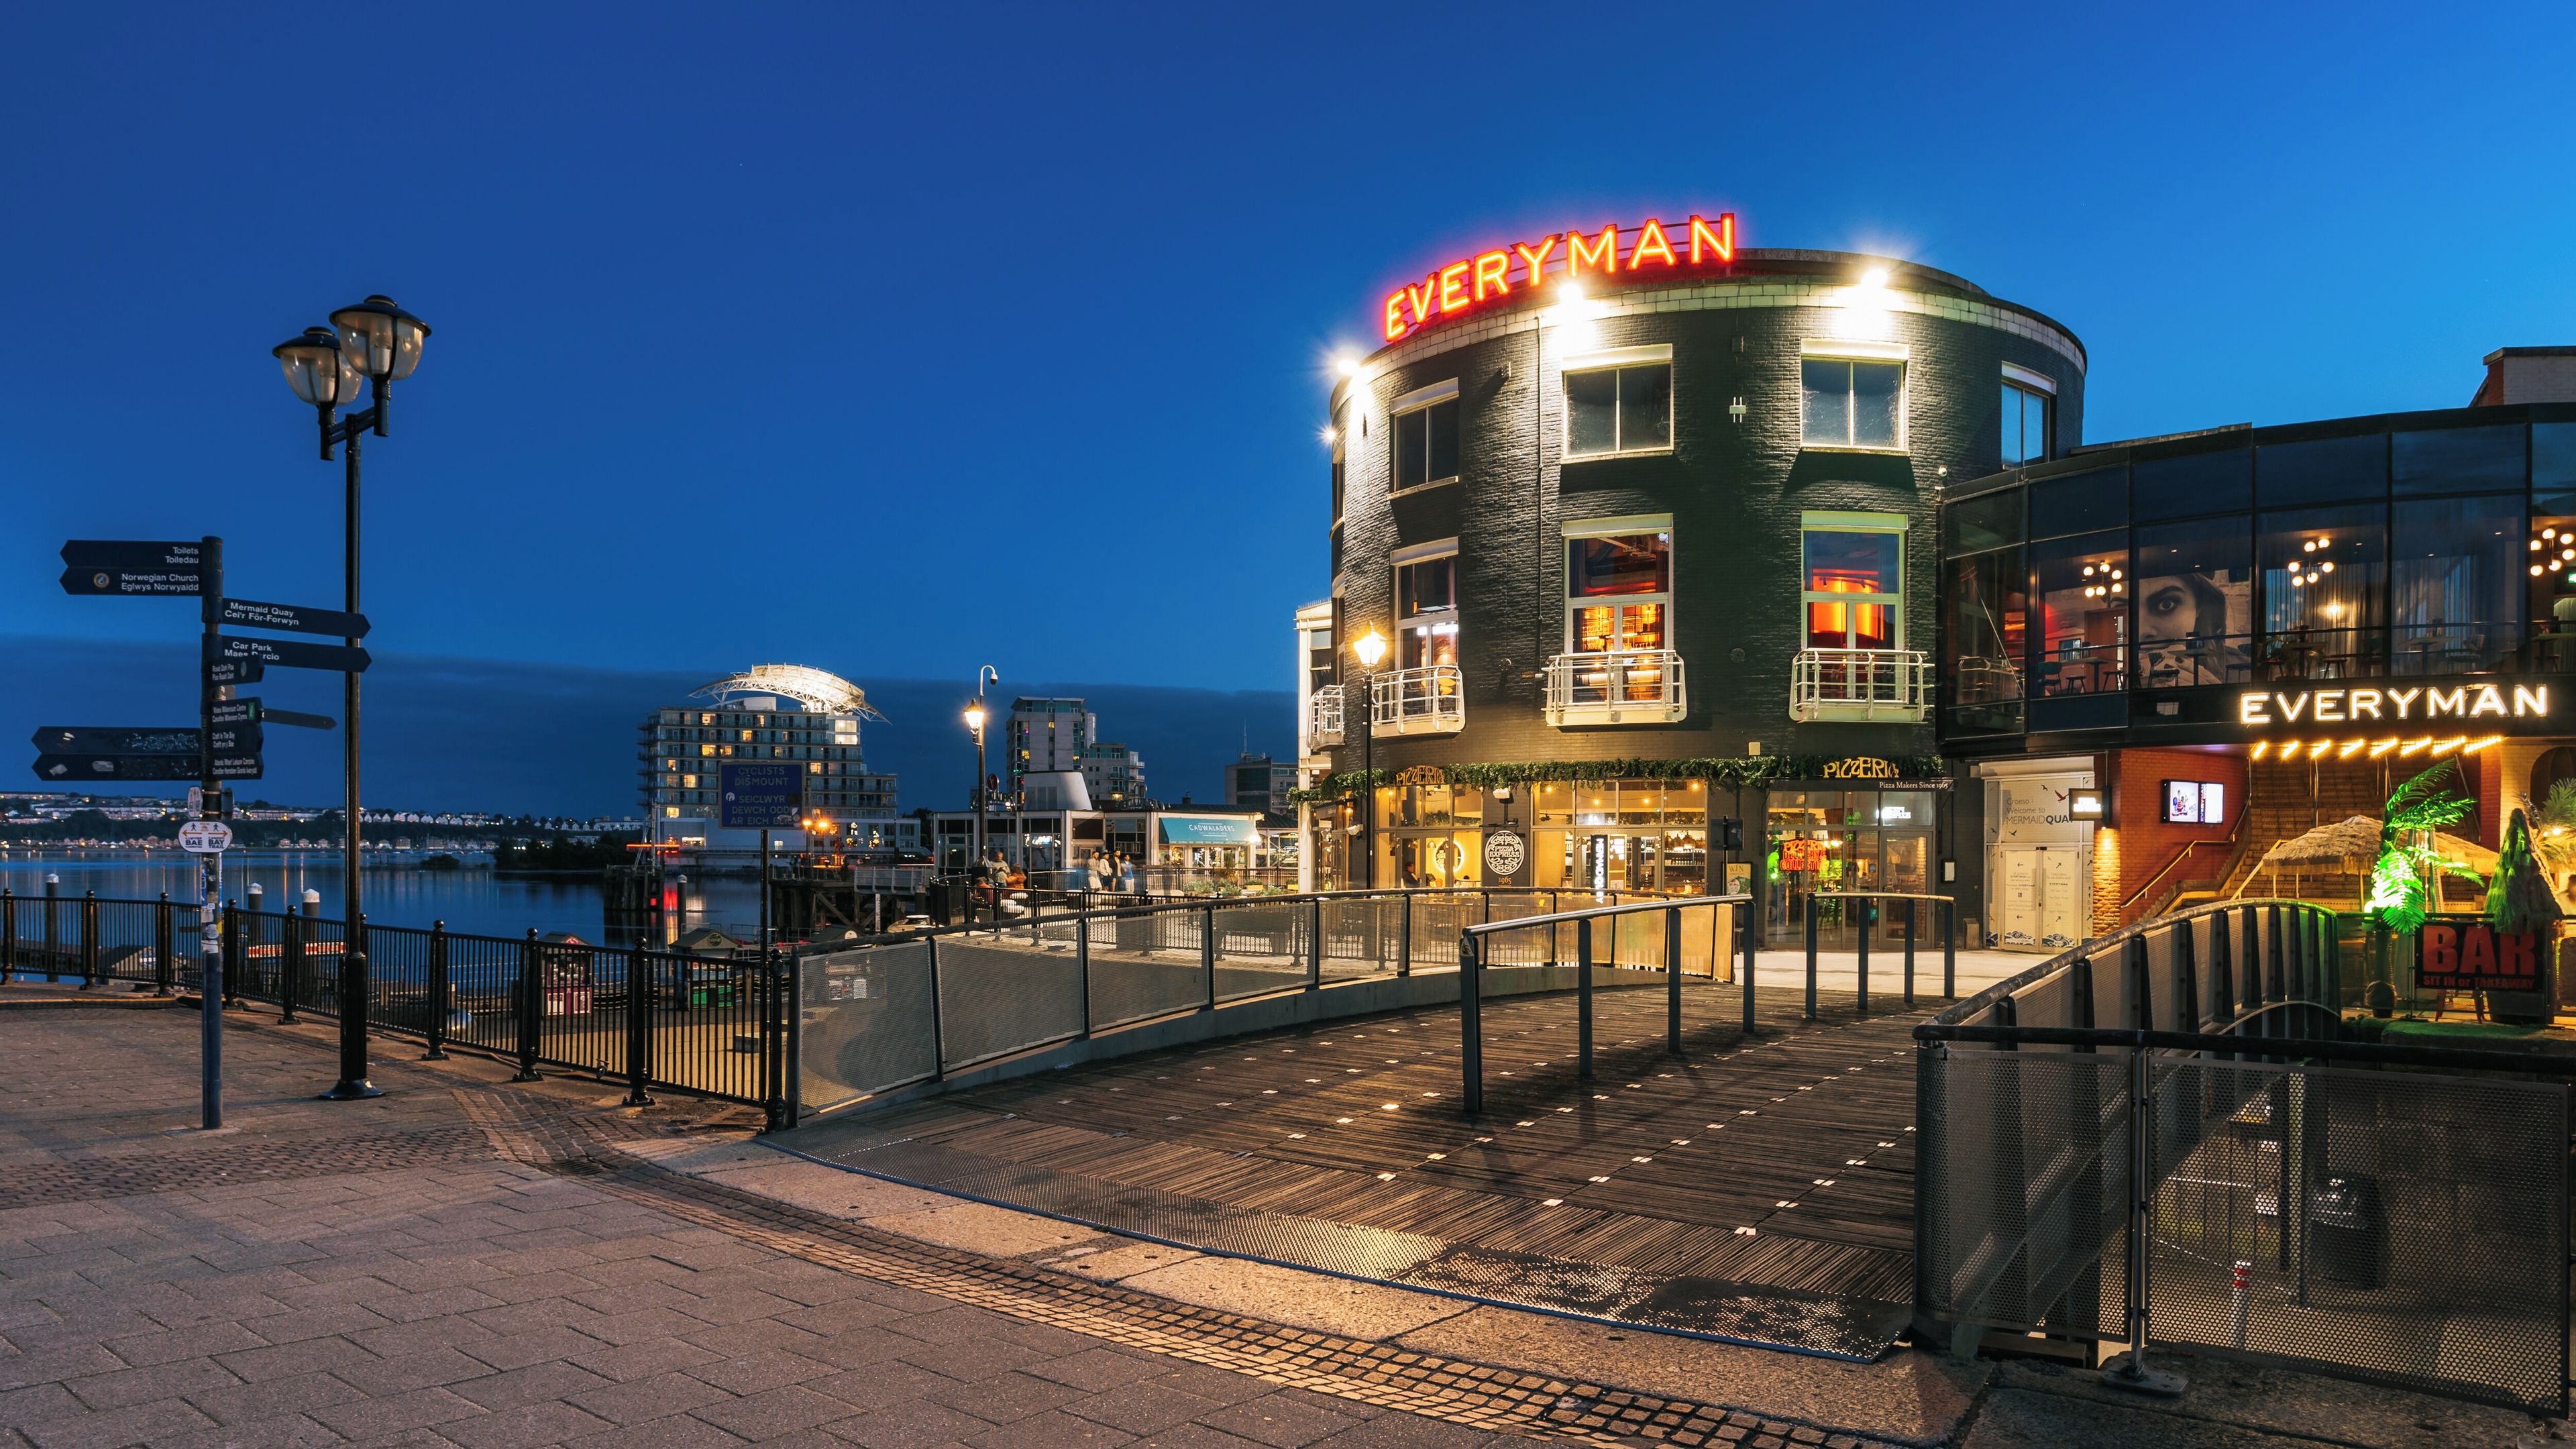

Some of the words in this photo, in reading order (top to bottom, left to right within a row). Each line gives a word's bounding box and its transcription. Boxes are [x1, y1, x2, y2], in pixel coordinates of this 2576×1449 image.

[1385, 212, 1735, 343] EVERYMAN
[165, 555, 199, 564] Toiledau
[121, 574, 166, 582] Norwegian
[169, 574, 199, 582] Church
[121, 582, 151, 592] Eglwys
[154, 583, 199, 592] Norwyaidd
[225, 610, 246, 619] Cei'r
[230, 602, 268, 613] Mermaid
[271, 607, 294, 618] Quay
[232, 641, 249, 649] Car
[252, 643, 272, 651] Park
[2241, 684, 2550, 725] EVERYMAN
[738, 767, 785, 775] CYCLISTS
[1823, 757, 1899, 778] PIZZERIA
[1396, 765, 1447, 786] PIZZERIA
[735, 777, 788, 786] DISMOUNT
[1896, 781, 1918, 789] Makers
[1920, 781, 1936, 789] Since
[1936, 781, 1949, 790] 1965
[739, 795, 786, 804] SEICLWYR
[731, 817, 744, 825] AR
[747, 817, 769, 825] EICH
[1188, 824, 1235, 832] CADWALADERS
[1729, 864, 1744, 873] WIN
[1498, 876, 1512, 885] 1965
[2423, 925, 2536, 975] BAR
[2423, 975, 2441, 986] SIT
[2444, 976, 2456, 987] IN
[2458, 979, 2471, 987] or
[2474, 977, 2535, 989] TAKEAWAY
